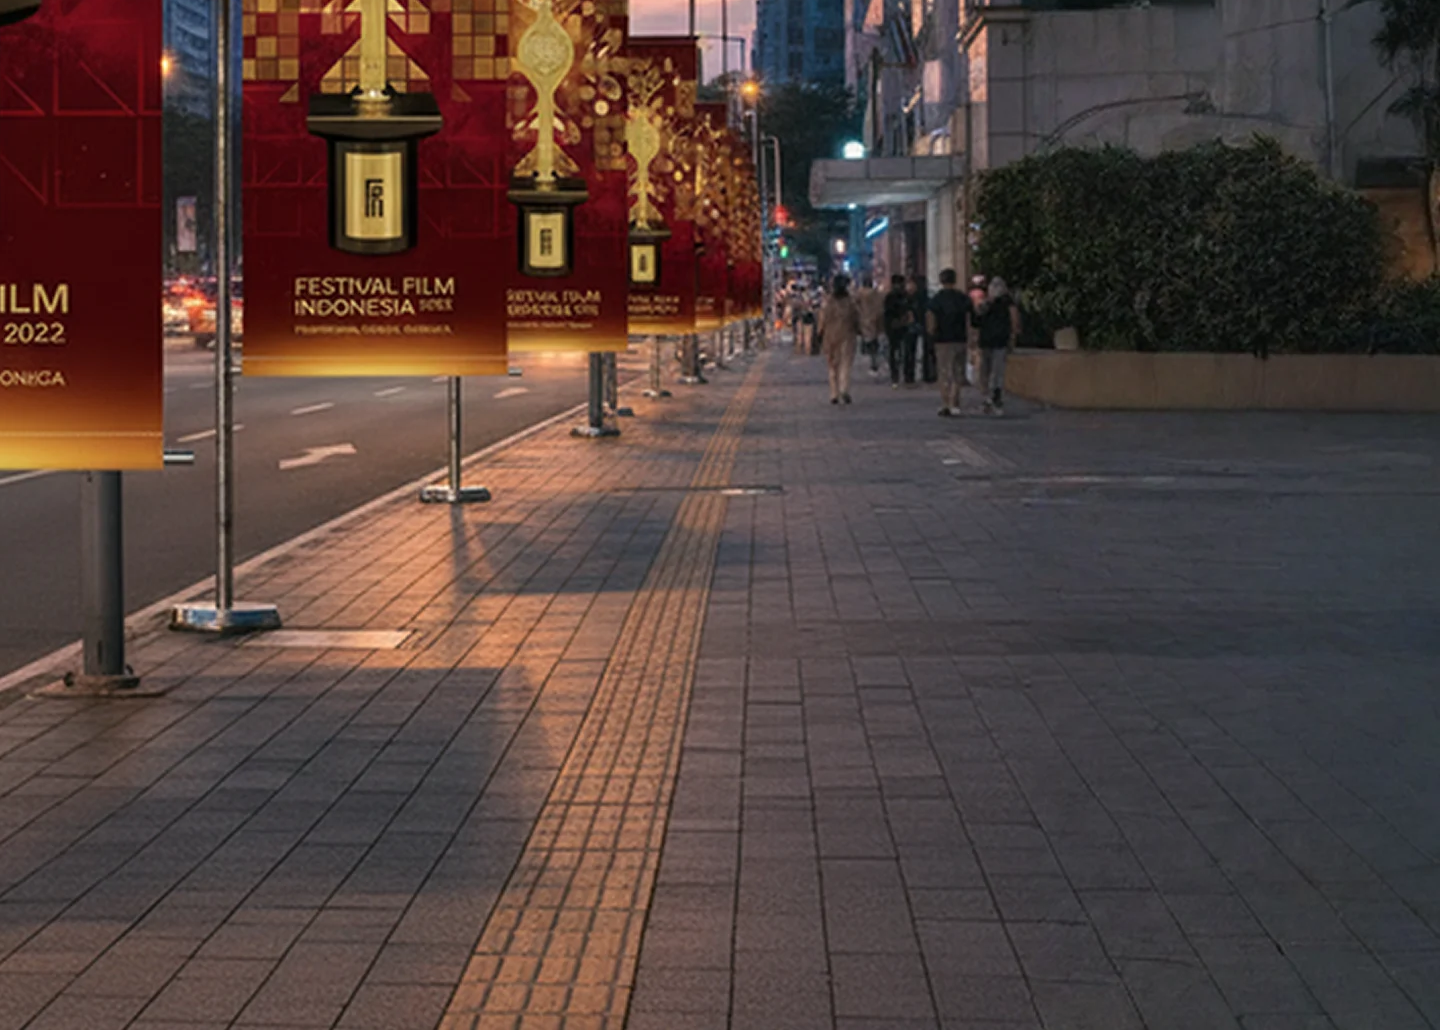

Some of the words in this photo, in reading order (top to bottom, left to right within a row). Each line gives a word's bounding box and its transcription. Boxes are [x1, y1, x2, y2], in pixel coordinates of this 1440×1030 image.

[295, 276, 399, 296] FESTIVAL
[402, 276, 456, 296] FILM
[294, 298, 416, 317] INDONESIA
[3, 321, 67, 345] 2022
